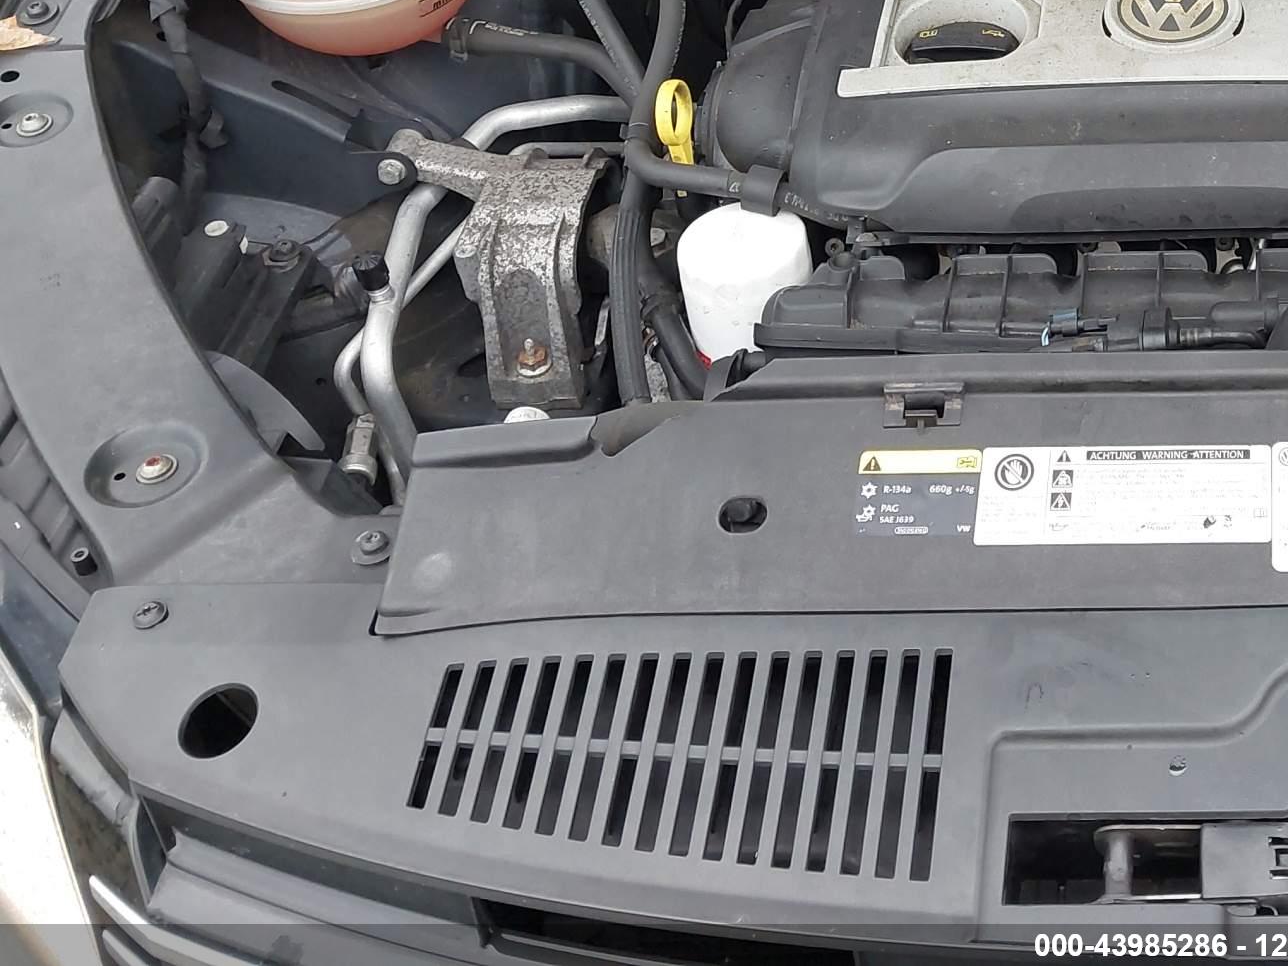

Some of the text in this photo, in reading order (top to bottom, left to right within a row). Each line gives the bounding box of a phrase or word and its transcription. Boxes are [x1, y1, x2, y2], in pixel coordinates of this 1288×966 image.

[1090, 449, 1244, 461] ACHTUNG WARNING ATTENTION
[883, 485, 912, 494] R-134a
[929, 484, 952, 495] 660g
[880, 504, 900, 513] PAG
[879, 516, 895, 524] SAE
